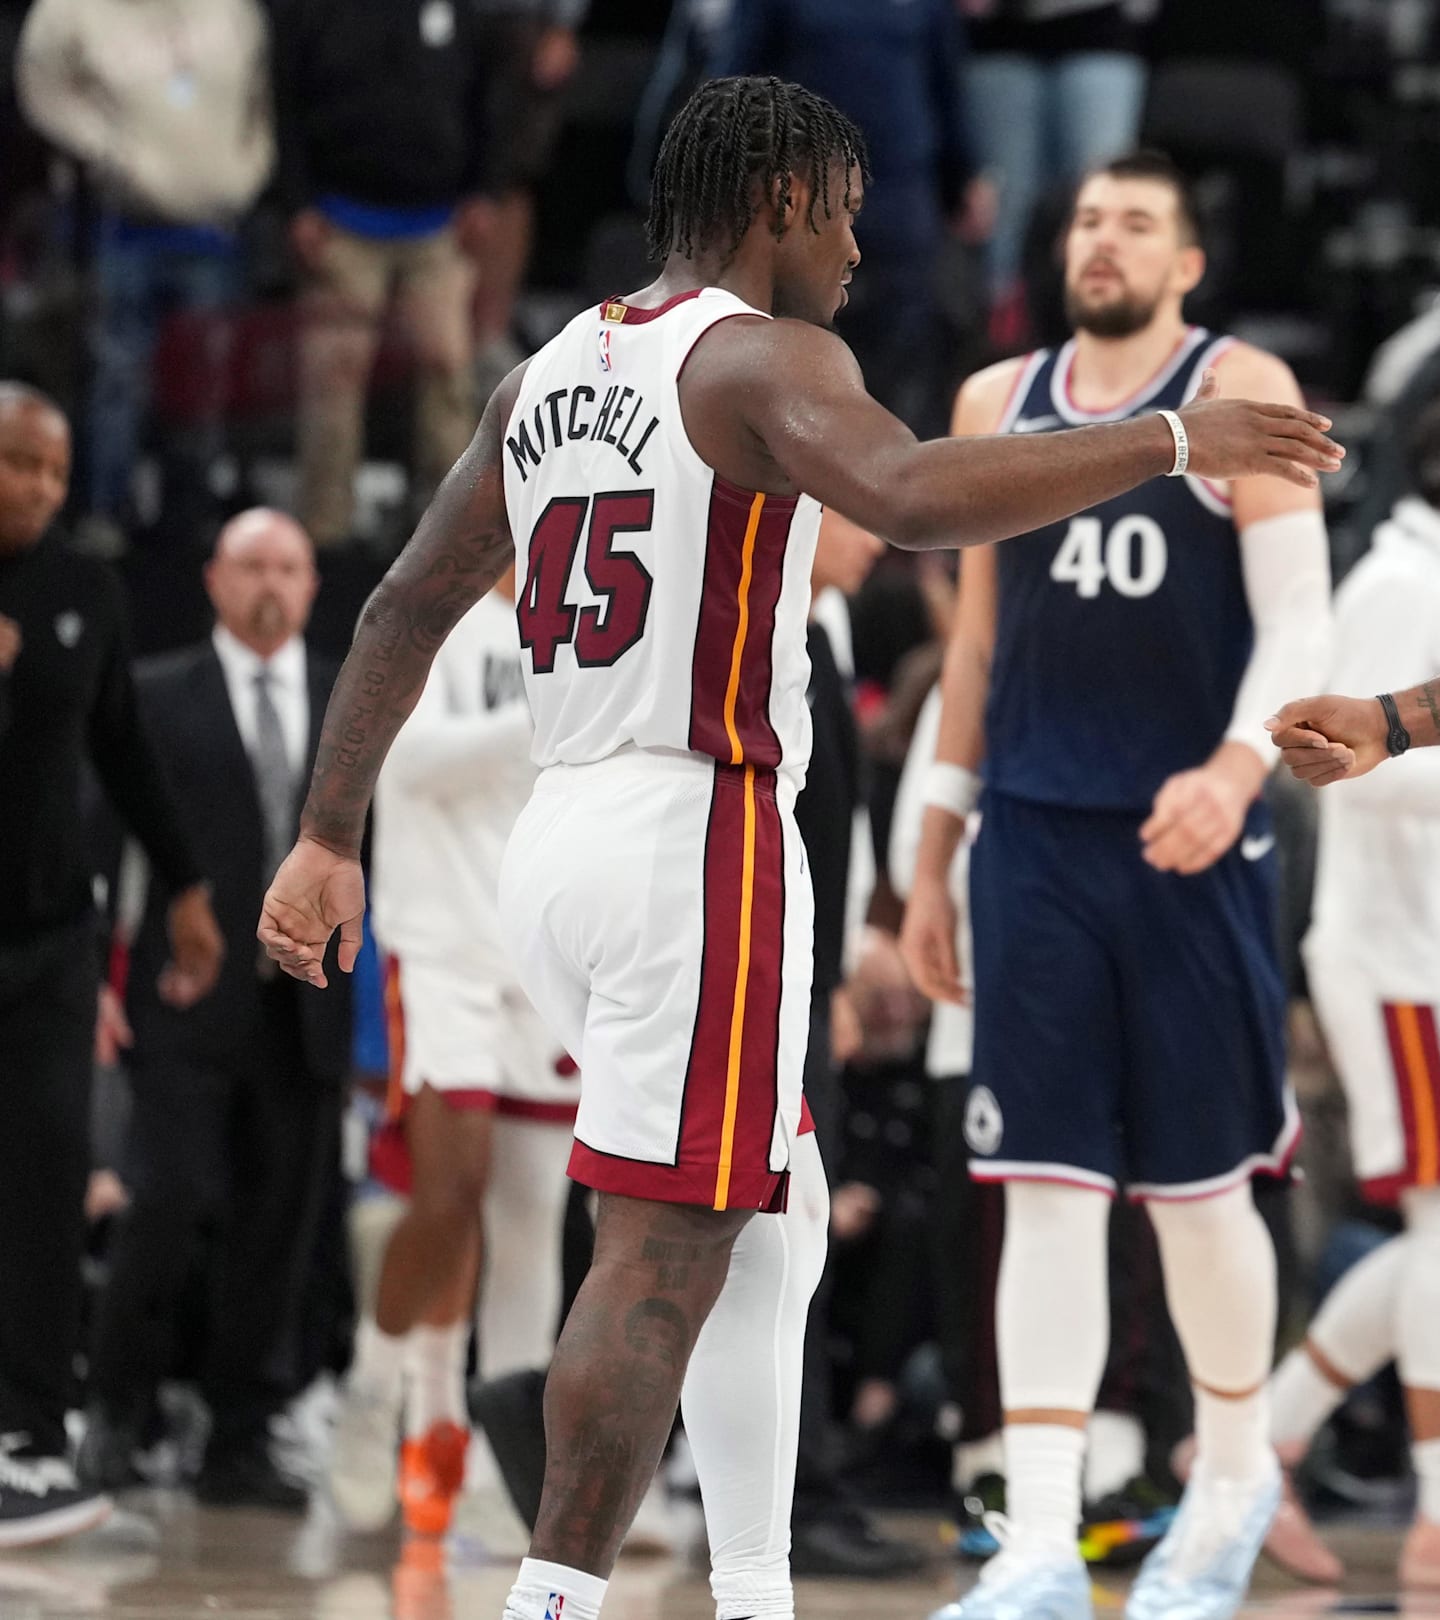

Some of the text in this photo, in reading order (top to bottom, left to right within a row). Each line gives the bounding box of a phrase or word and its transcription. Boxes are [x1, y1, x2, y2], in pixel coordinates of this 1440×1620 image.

[506, 385, 659, 482] MITCHELL
[516, 488, 655, 674] 45
[1050, 514, 1167, 598] 40
